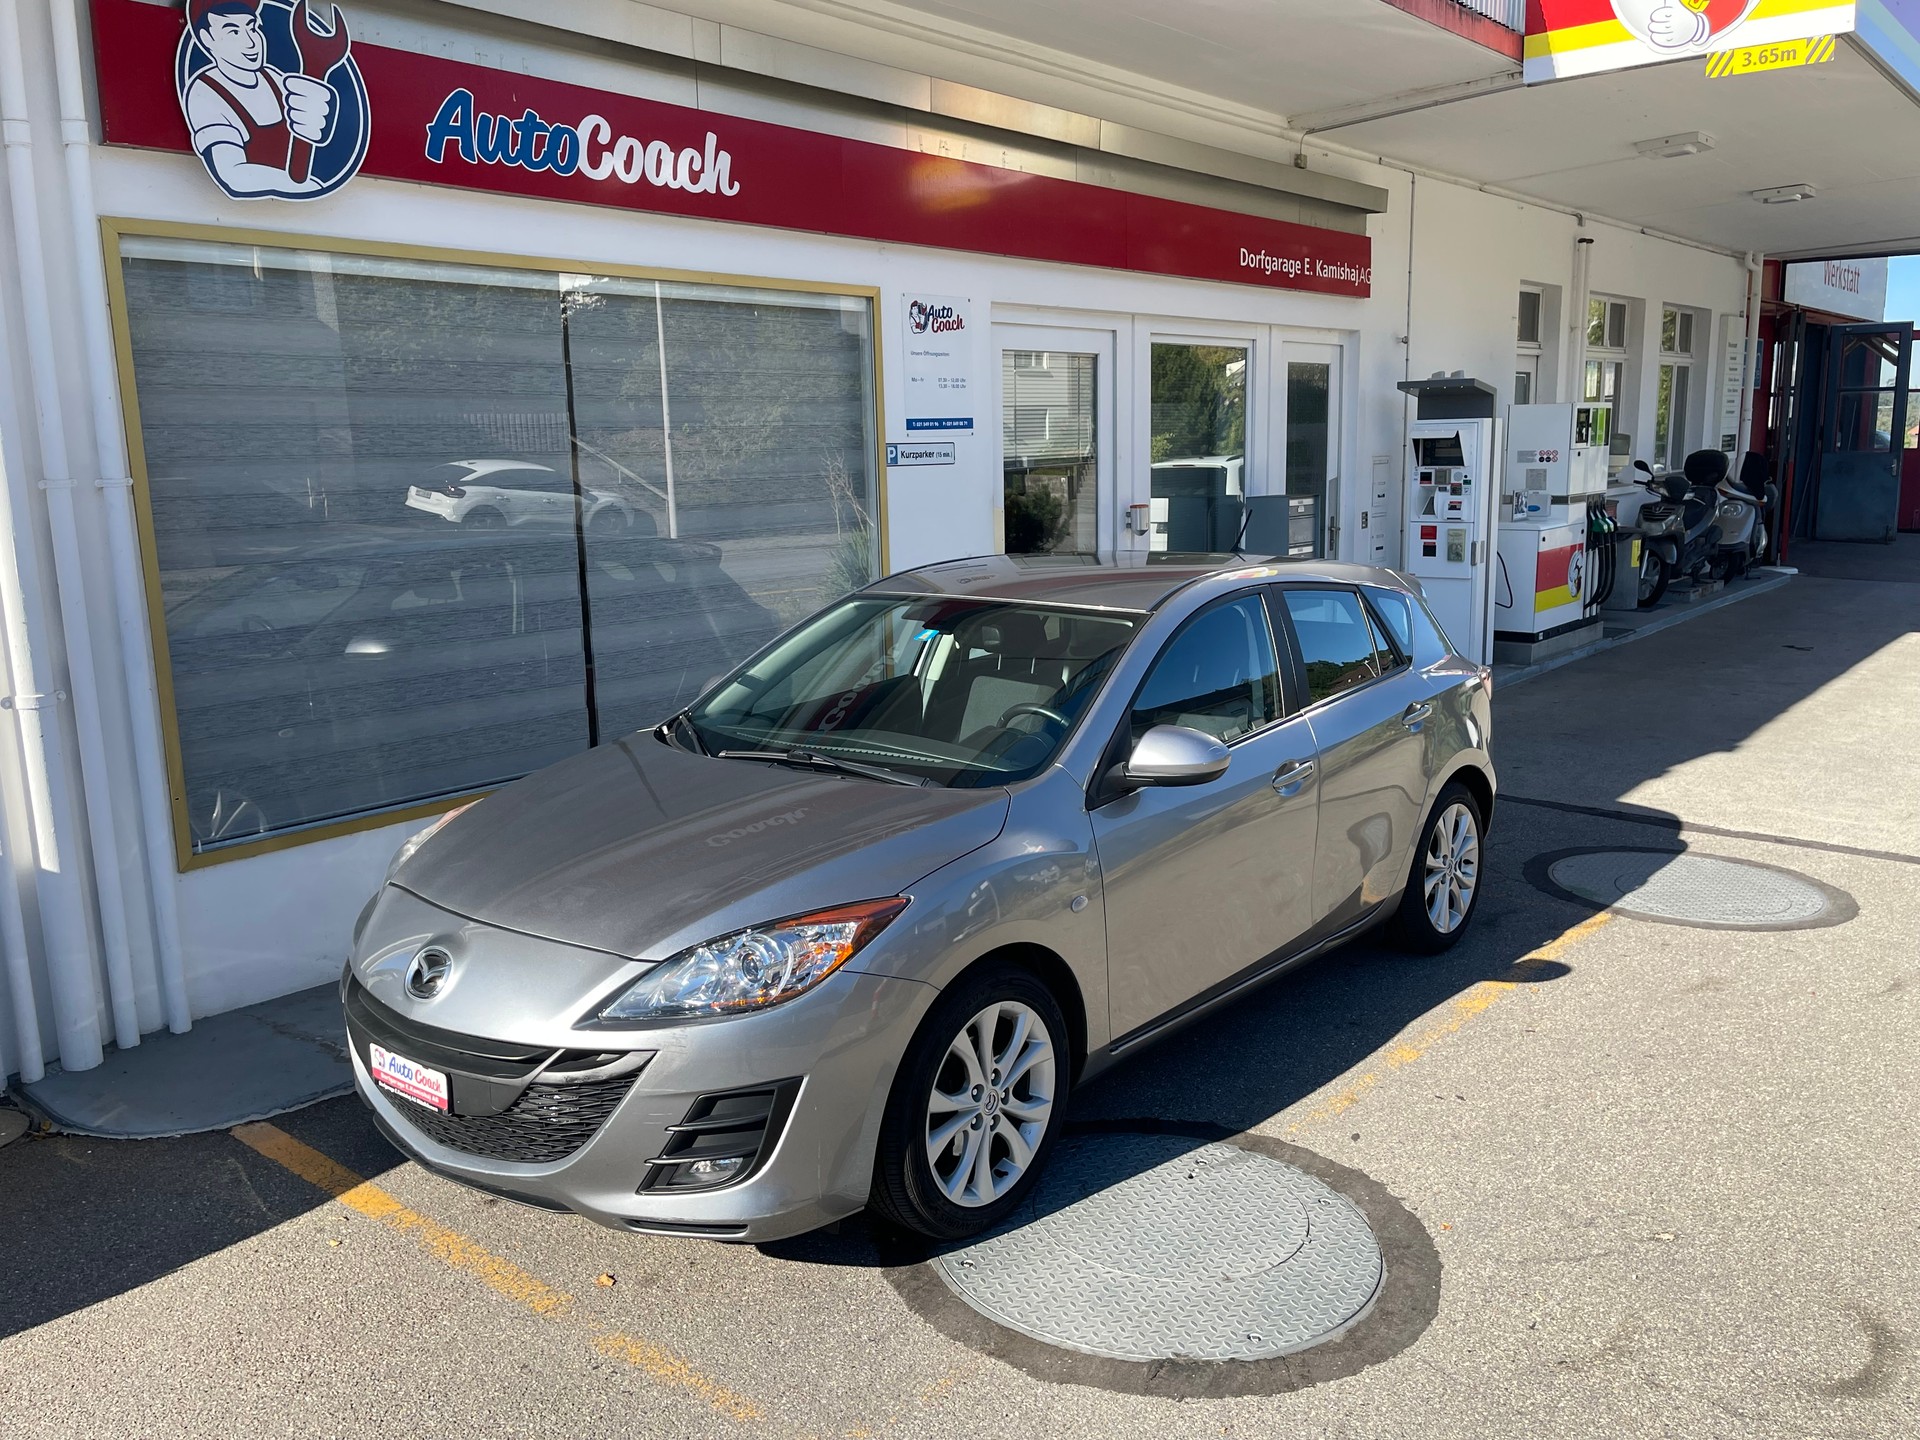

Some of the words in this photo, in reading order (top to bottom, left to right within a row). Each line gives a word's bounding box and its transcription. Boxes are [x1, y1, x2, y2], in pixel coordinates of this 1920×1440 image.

[1741, 47, 1797, 68] 3.65m
[1240, 247, 1301, 278] Dorfgarage
[1304, 258, 1313, 275] E.
[1316, 259, 1359, 286] Kamishaj
[1360, 267, 1372, 284] AG
[1824, 260, 1860, 295] Werkstatt
[928, 304, 953, 319] Auto
[931, 314, 965, 333] Coach
[900, 450, 934, 460] Kurzparker
[388, 1056, 413, 1081] Auto
[415, 1070, 442, 1093] Coach
